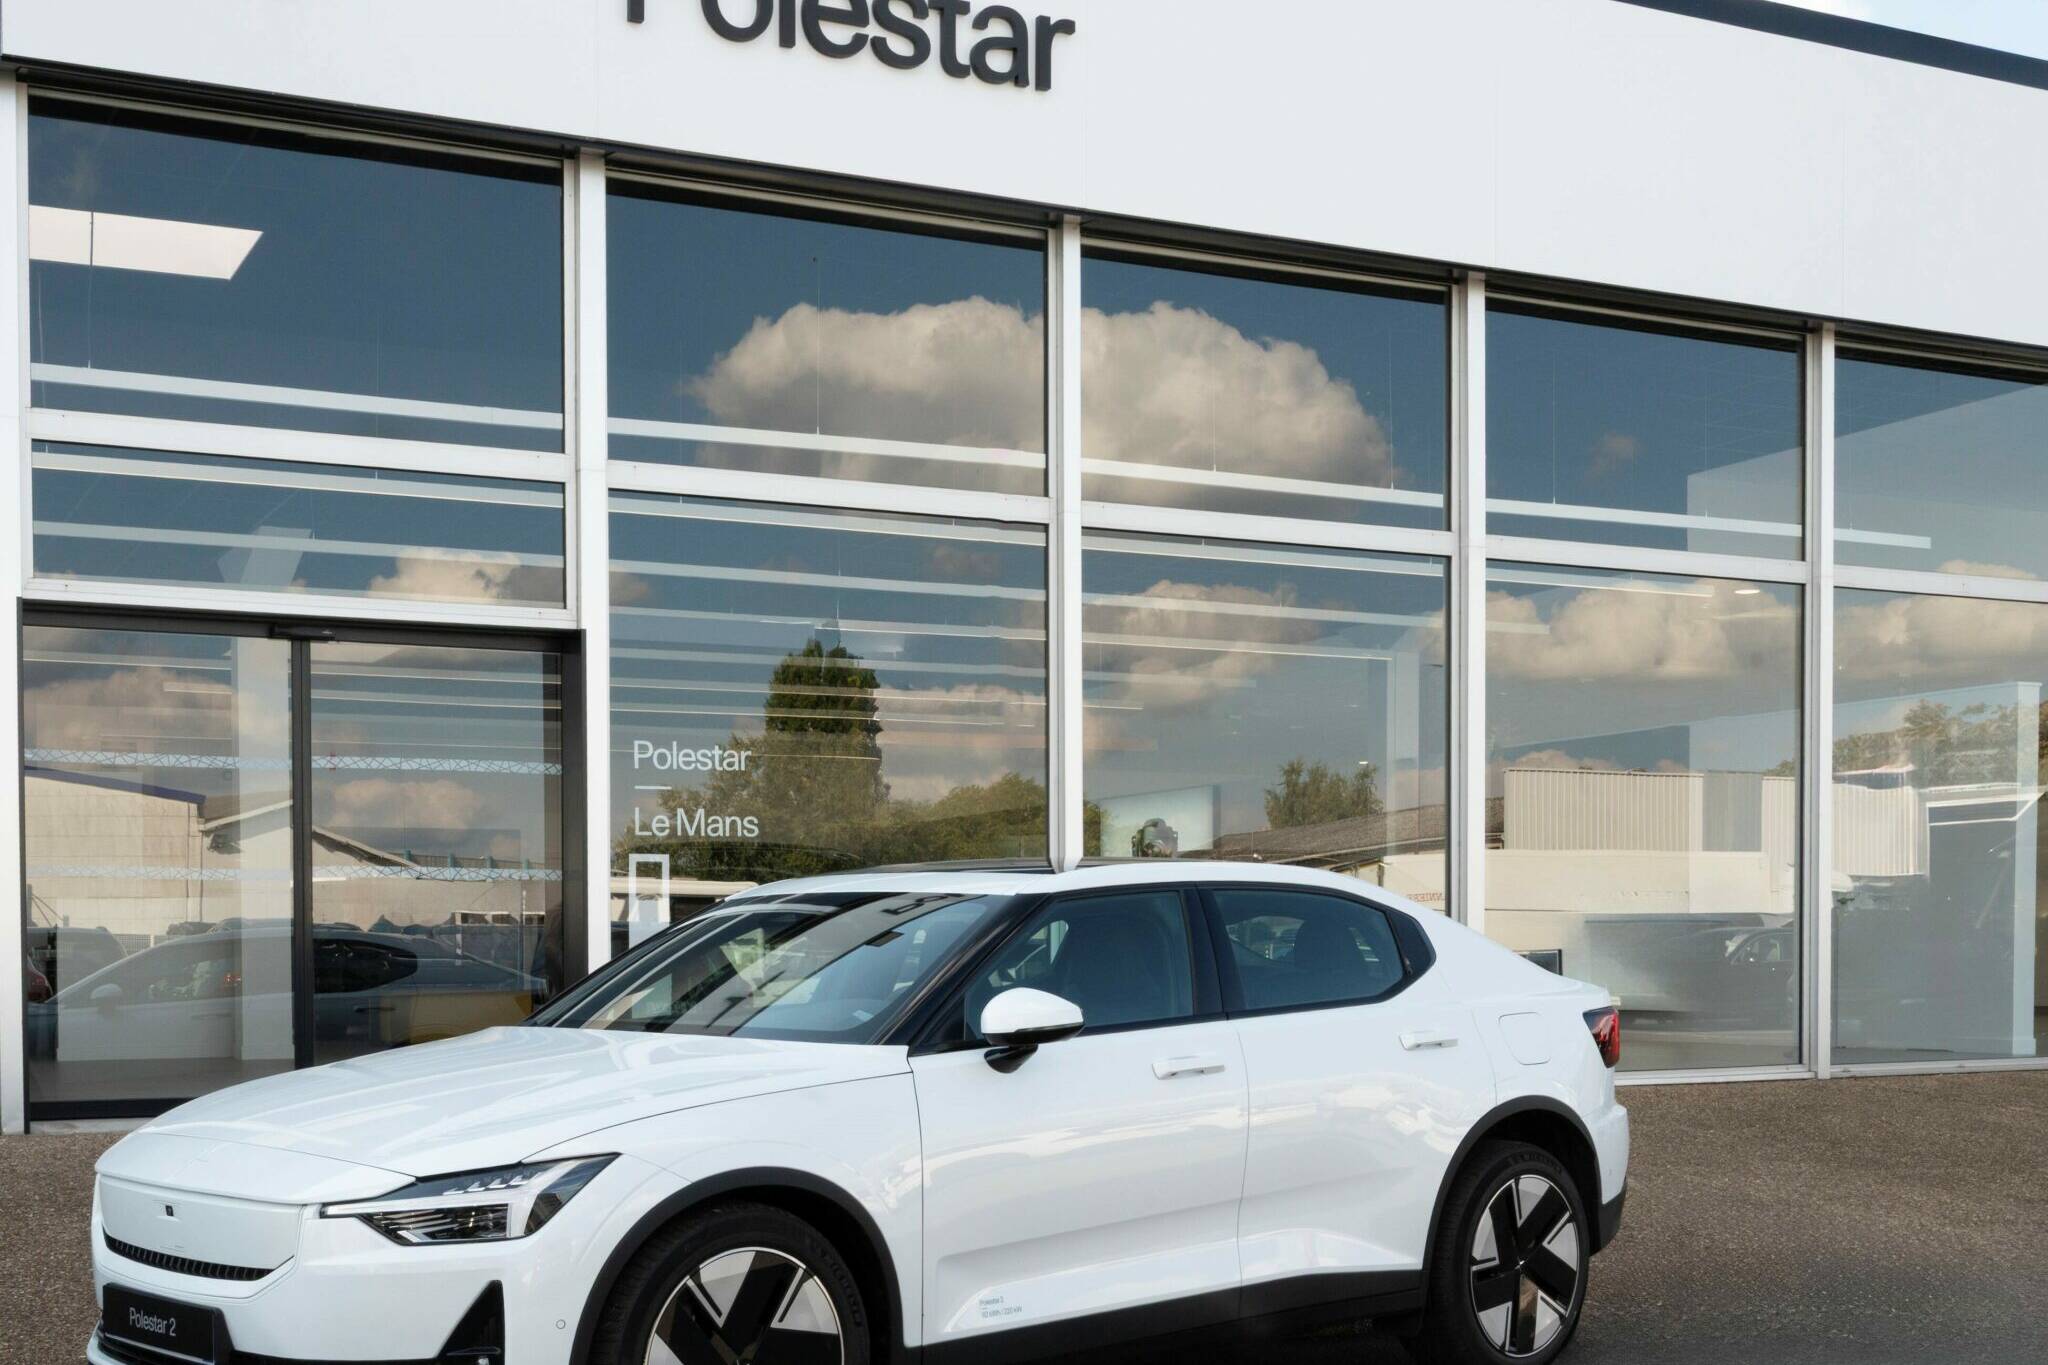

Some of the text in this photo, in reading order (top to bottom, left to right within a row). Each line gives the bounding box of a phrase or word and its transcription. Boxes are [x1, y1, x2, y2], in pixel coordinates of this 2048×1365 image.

[627, 0, 1075, 91] oestar
[633, 740, 752, 771] Polestar
[634, 807, 760, 838] Le Mans
[129, 1306, 177, 1337] Polestar 2
